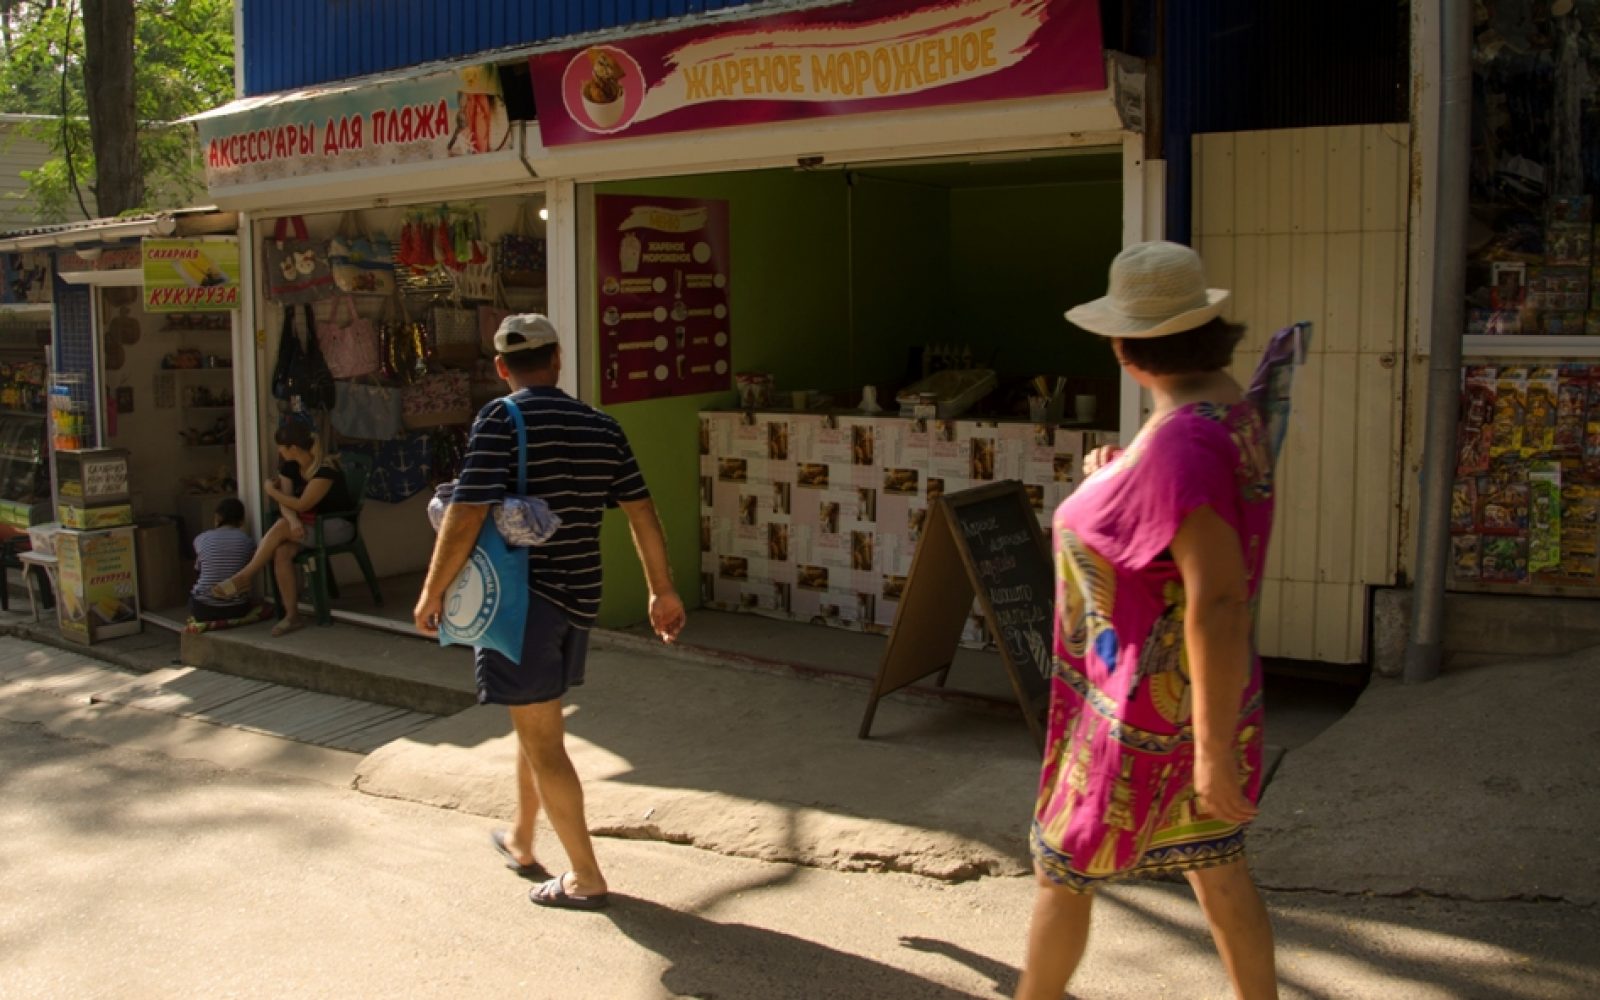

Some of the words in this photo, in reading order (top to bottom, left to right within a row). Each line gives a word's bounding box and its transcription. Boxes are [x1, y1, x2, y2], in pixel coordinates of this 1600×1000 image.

[683, 53, 805, 100] ЖАРЕНОЕ
[811, 27, 997, 95] МОРОЖЕНОЕ
[209, 120, 315, 167] АКСЕССУАРЫ
[323, 112, 363, 155] ДЛЯ
[371, 99, 449, 145] ПЛЯЖА
[147, 248, 199, 260] САХАРНАЯ
[149, 287, 238, 305] КУКУРУЗА
[90, 571, 131, 586] КУКУРУЗА
